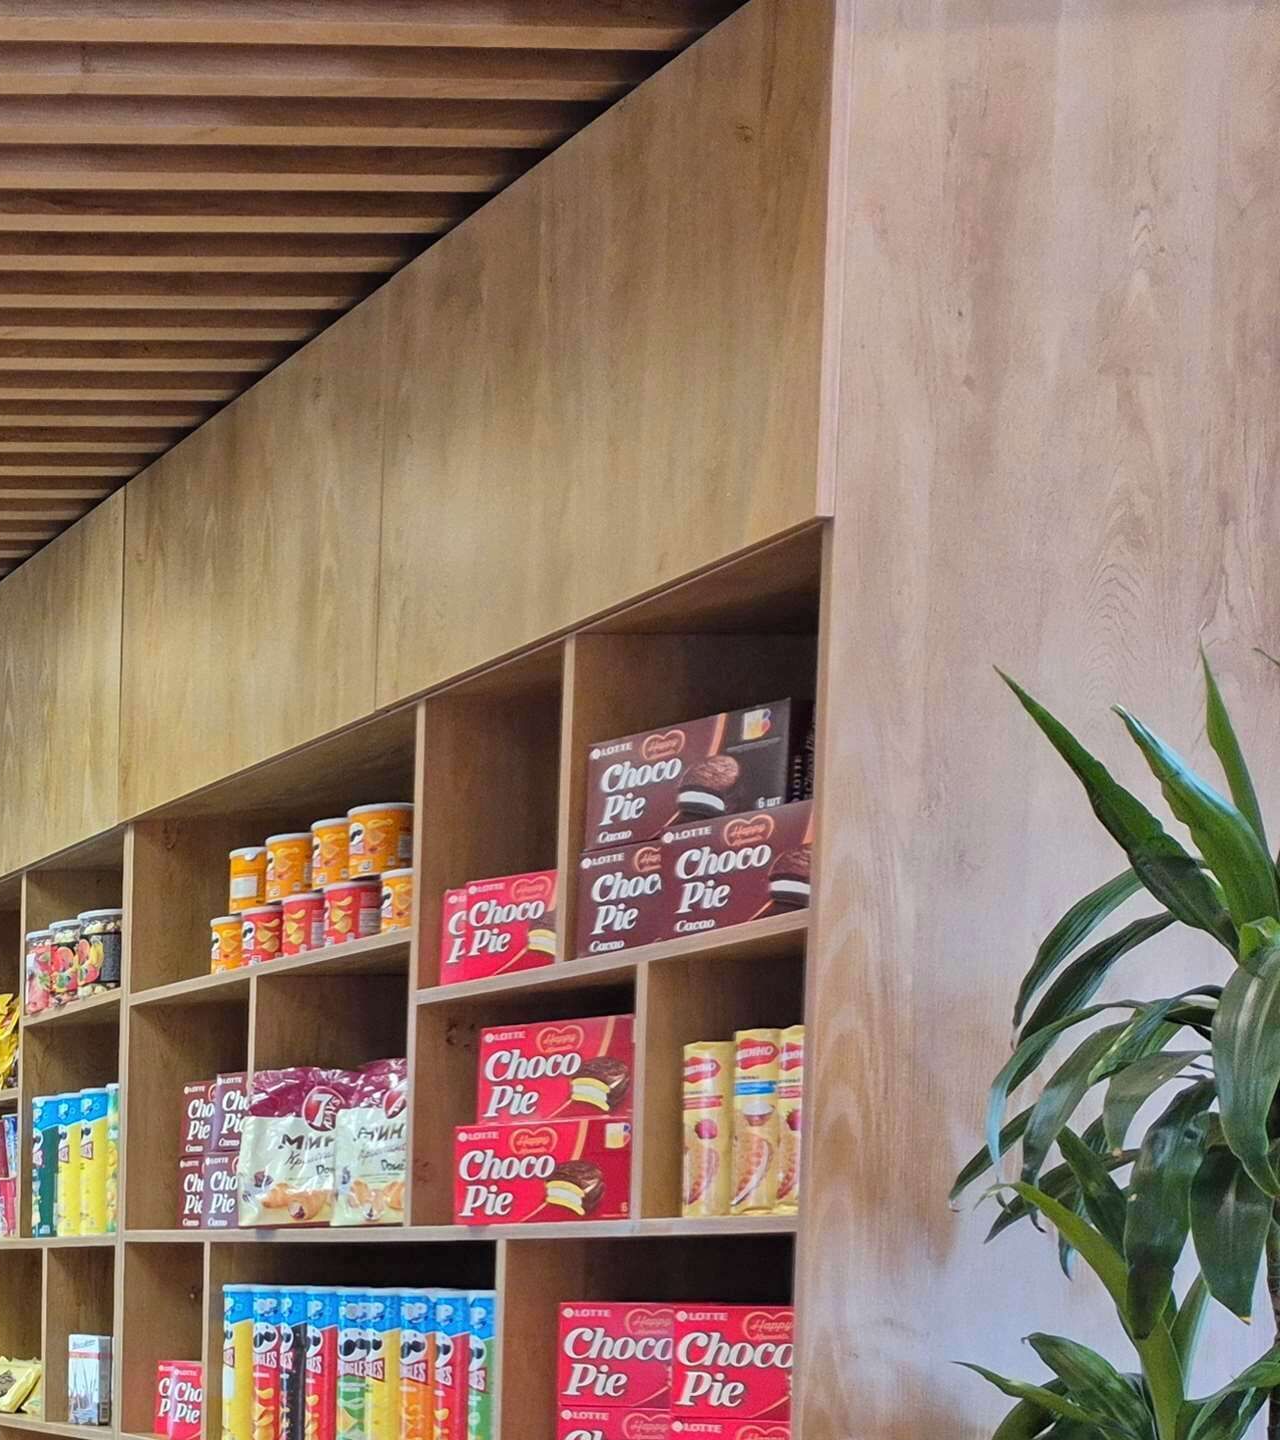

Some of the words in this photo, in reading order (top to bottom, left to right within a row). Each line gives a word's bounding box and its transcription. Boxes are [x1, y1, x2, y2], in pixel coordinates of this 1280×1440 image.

[602, 742, 633, 757] LOTTE
[600, 757, 682, 793] Choco
[599, 794, 646, 826] Pie
[675, 826, 711, 840] LOTTE
[591, 852, 625, 866] LOTTE
[676, 844, 771, 880] Choco
[676, 882, 730, 914] Pie
[469, 900, 545, 927] Choco
[591, 904, 639, 935] Pie
[468, 928, 511, 956] Pie
[494, 1031, 526, 1041] LOTTE
[484, 1049, 581, 1082] Choco
[312, 1094, 333, 1127] 7
[483, 1085, 539, 1117] Pie
[187, 1120, 210, 1140] Pie
[468, 1131, 498, 1140] LOTTE
[459, 1149, 555, 1181] Choco
[209, 1193, 235, 1214] Pie
[458, 1185, 513, 1217] Pie
[574, 1309, 611, 1317] LOTTE
[688, 1312, 728, 1321] LOTTE
[676, 1332, 794, 1368] Choco
[562, 1363, 628, 1396] Pie
[674, 1370, 745, 1407] Pie
[173, 1403, 200, 1424] Pie
[572, 1411, 609, 1420] LOTTE
[684, 1422, 722, 1433] LOTTE
